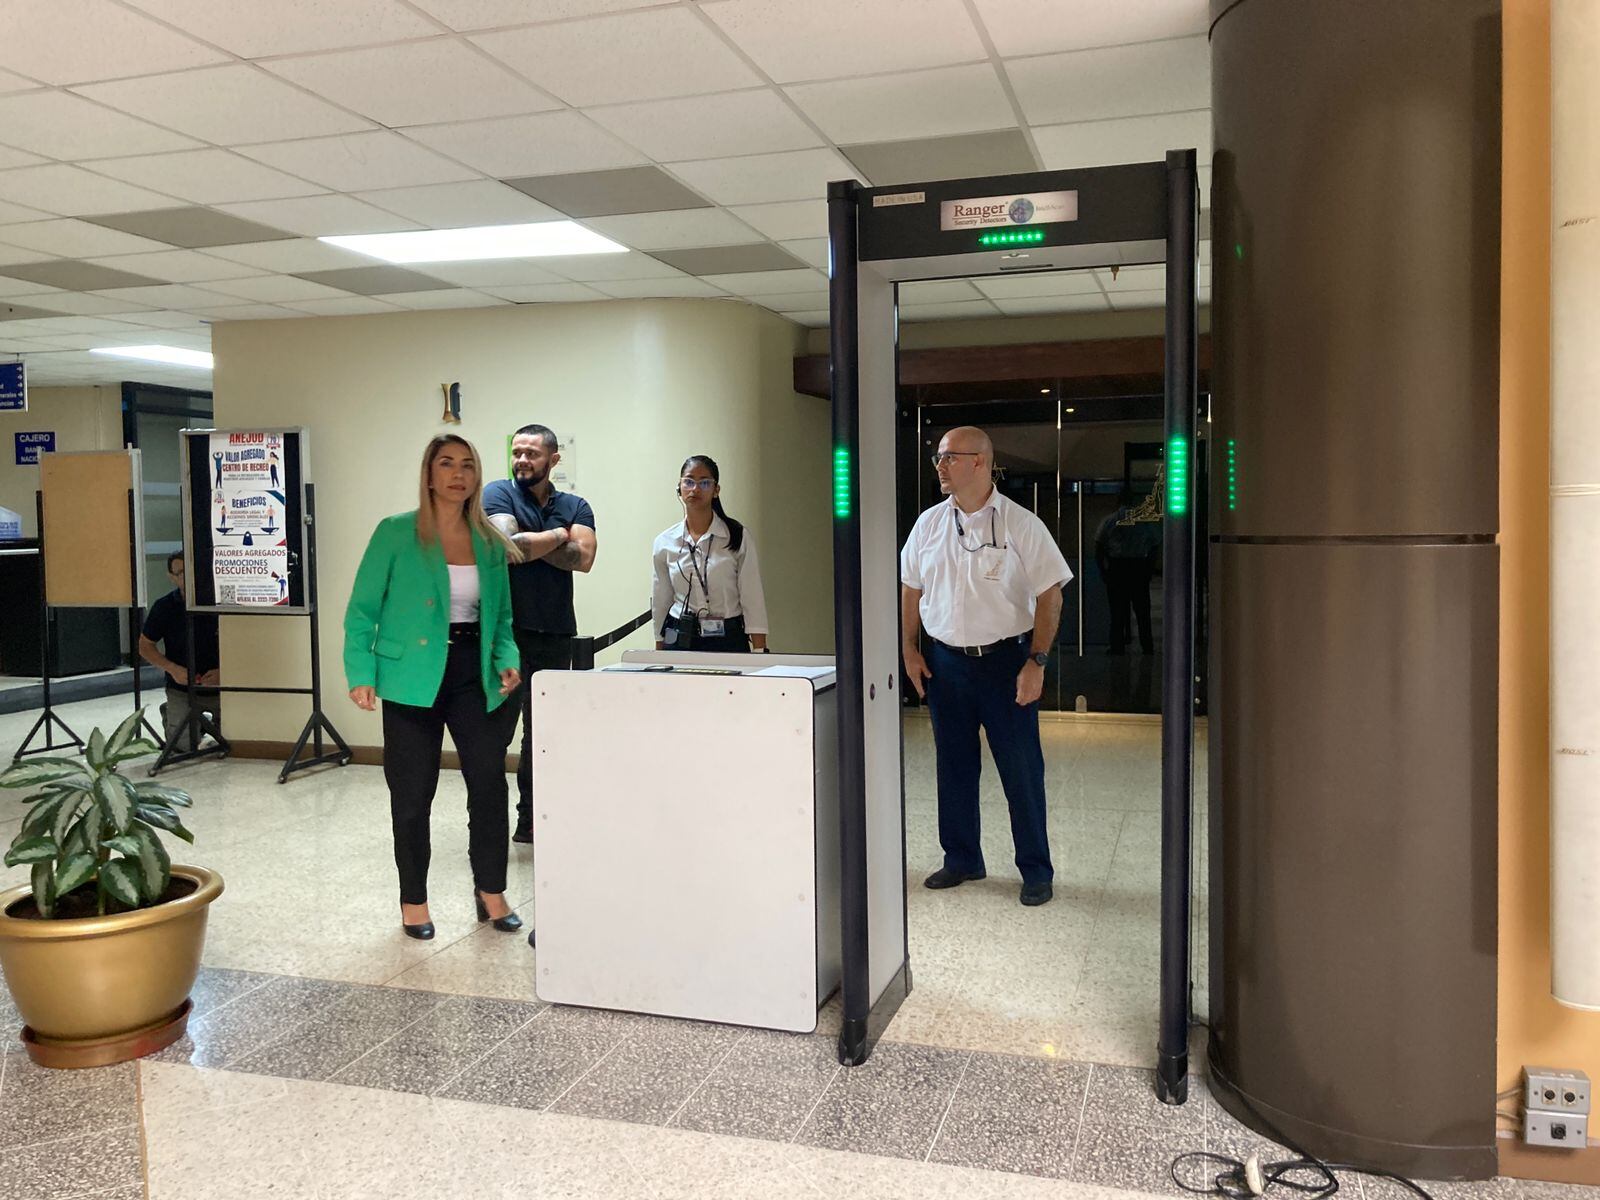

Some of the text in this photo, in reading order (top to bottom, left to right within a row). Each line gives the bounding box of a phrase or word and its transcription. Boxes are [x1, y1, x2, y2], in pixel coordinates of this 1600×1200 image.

[954, 204, 1005, 217] Ranger
[19, 434, 50, 442] CAJERO
[222, 463, 269, 472] CENTRO DE RECREO
[232, 496, 266, 508] BENEFICIOS
[245, 549, 286, 557] AGREGADOS
[215, 566, 269, 575] DESCUENTOS
